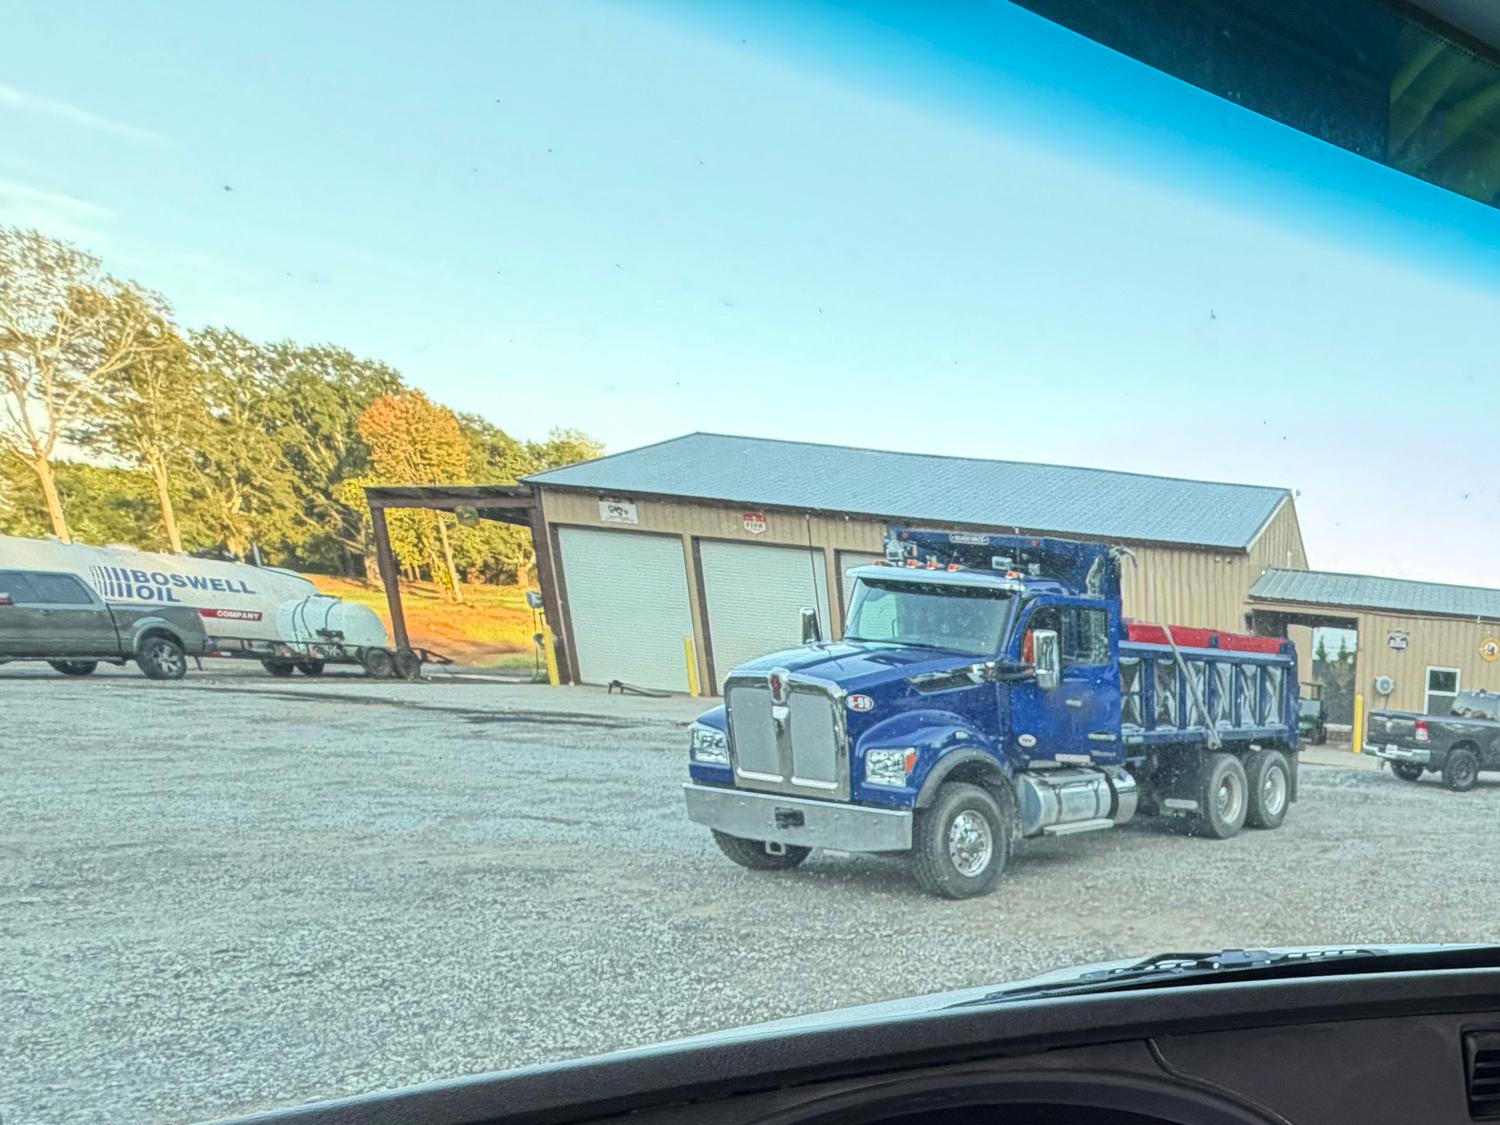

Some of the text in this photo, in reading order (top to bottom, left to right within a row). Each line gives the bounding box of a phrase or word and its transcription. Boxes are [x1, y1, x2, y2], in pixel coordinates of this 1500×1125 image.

[129, 569, 257, 595] BOSWELL
[135, 585, 182, 602] OIL
[216, 610, 260, 620] COMPANY
